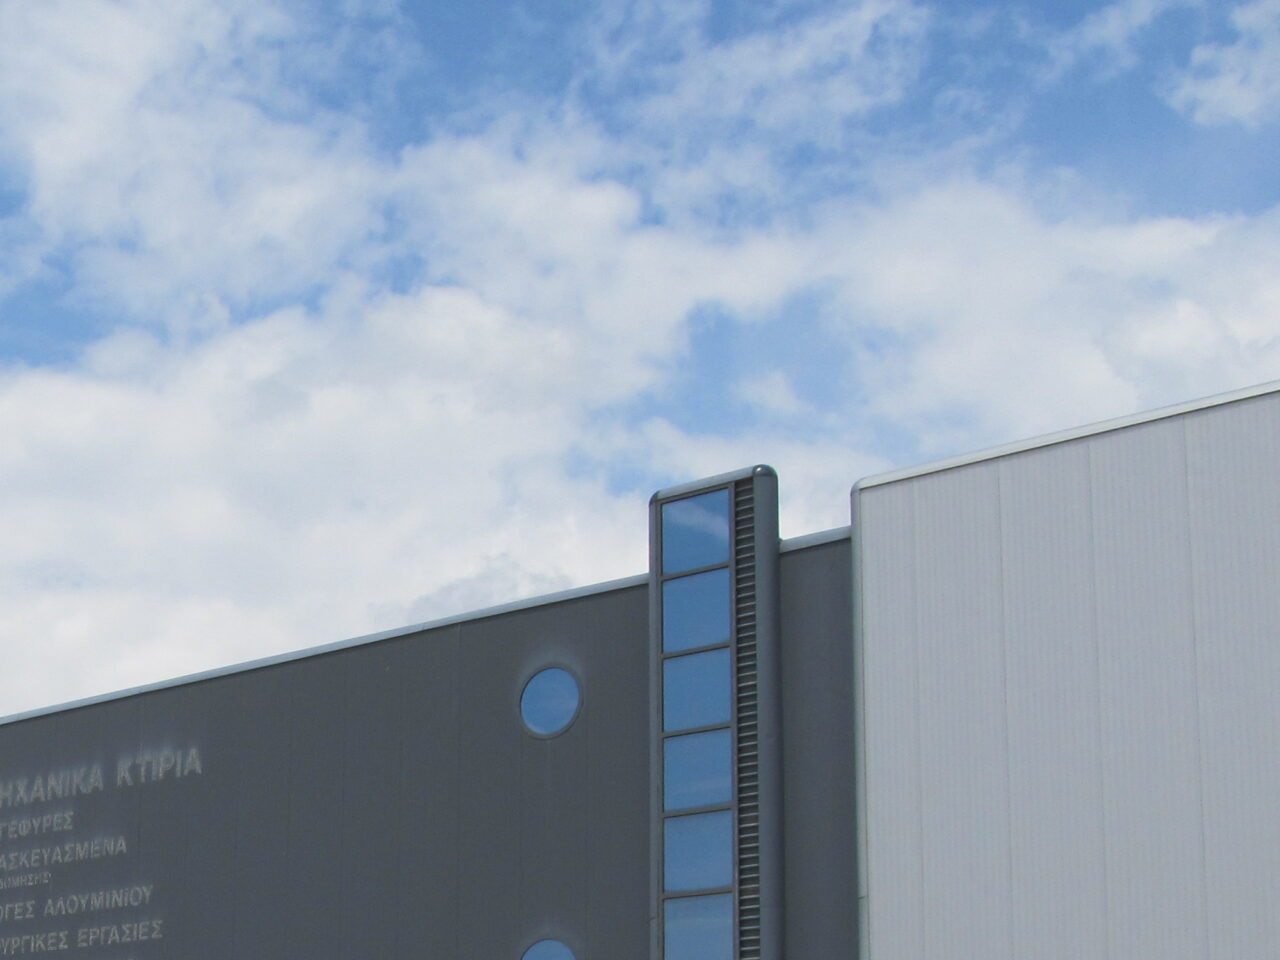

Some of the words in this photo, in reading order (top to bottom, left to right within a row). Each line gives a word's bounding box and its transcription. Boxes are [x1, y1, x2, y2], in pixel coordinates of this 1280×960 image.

[116, 748, 202, 787] ΚΤΙΡΙΑ
[43, 885, 154, 917] ΑΛΟΥΜΙΝΙΟΥ
[77, 919, 163, 948] ΕΡΓΑΣΙΕΣ
